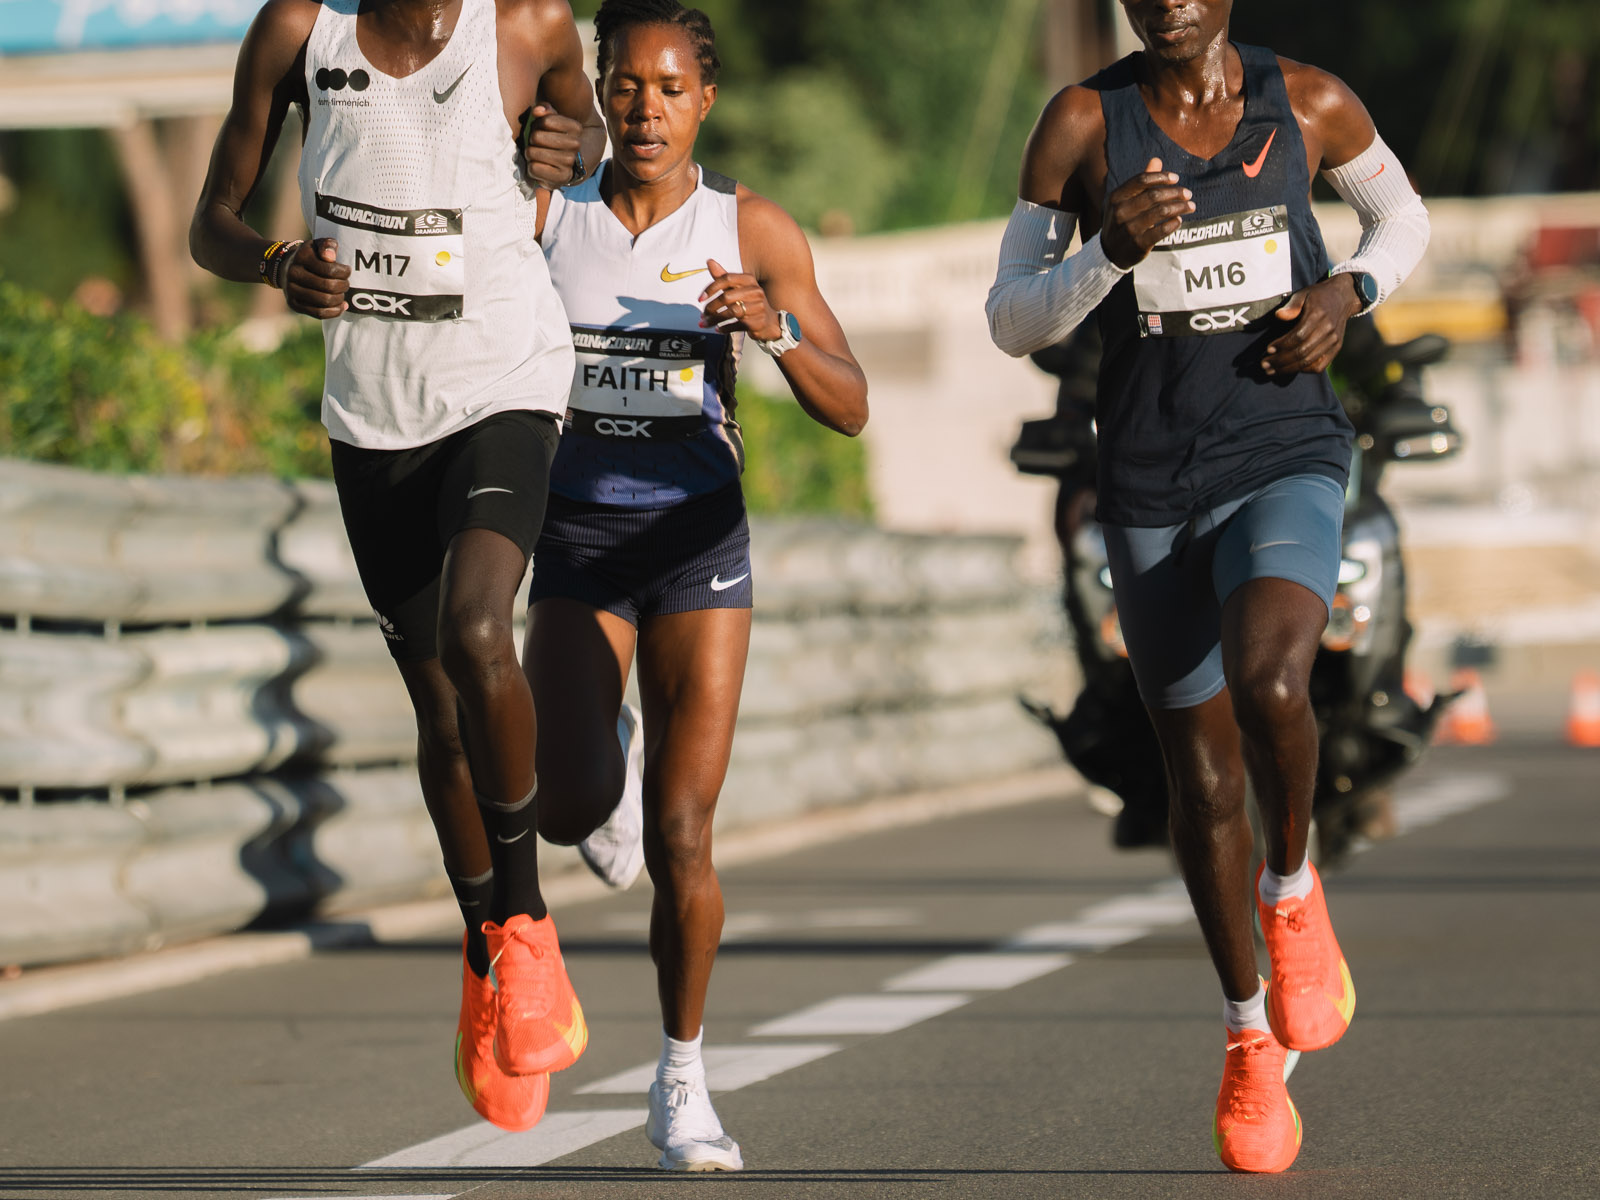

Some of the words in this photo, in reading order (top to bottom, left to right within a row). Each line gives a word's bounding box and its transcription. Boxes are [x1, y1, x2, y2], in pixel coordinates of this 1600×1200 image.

[327, 201, 408, 230] MONACORUN
[1155, 220, 1235, 246] NACORUN
[354, 249, 411, 277] M17
[1184, 261, 1246, 293] M16
[583, 364, 669, 392] FAITH
[622, 396, 628, 407] 1
